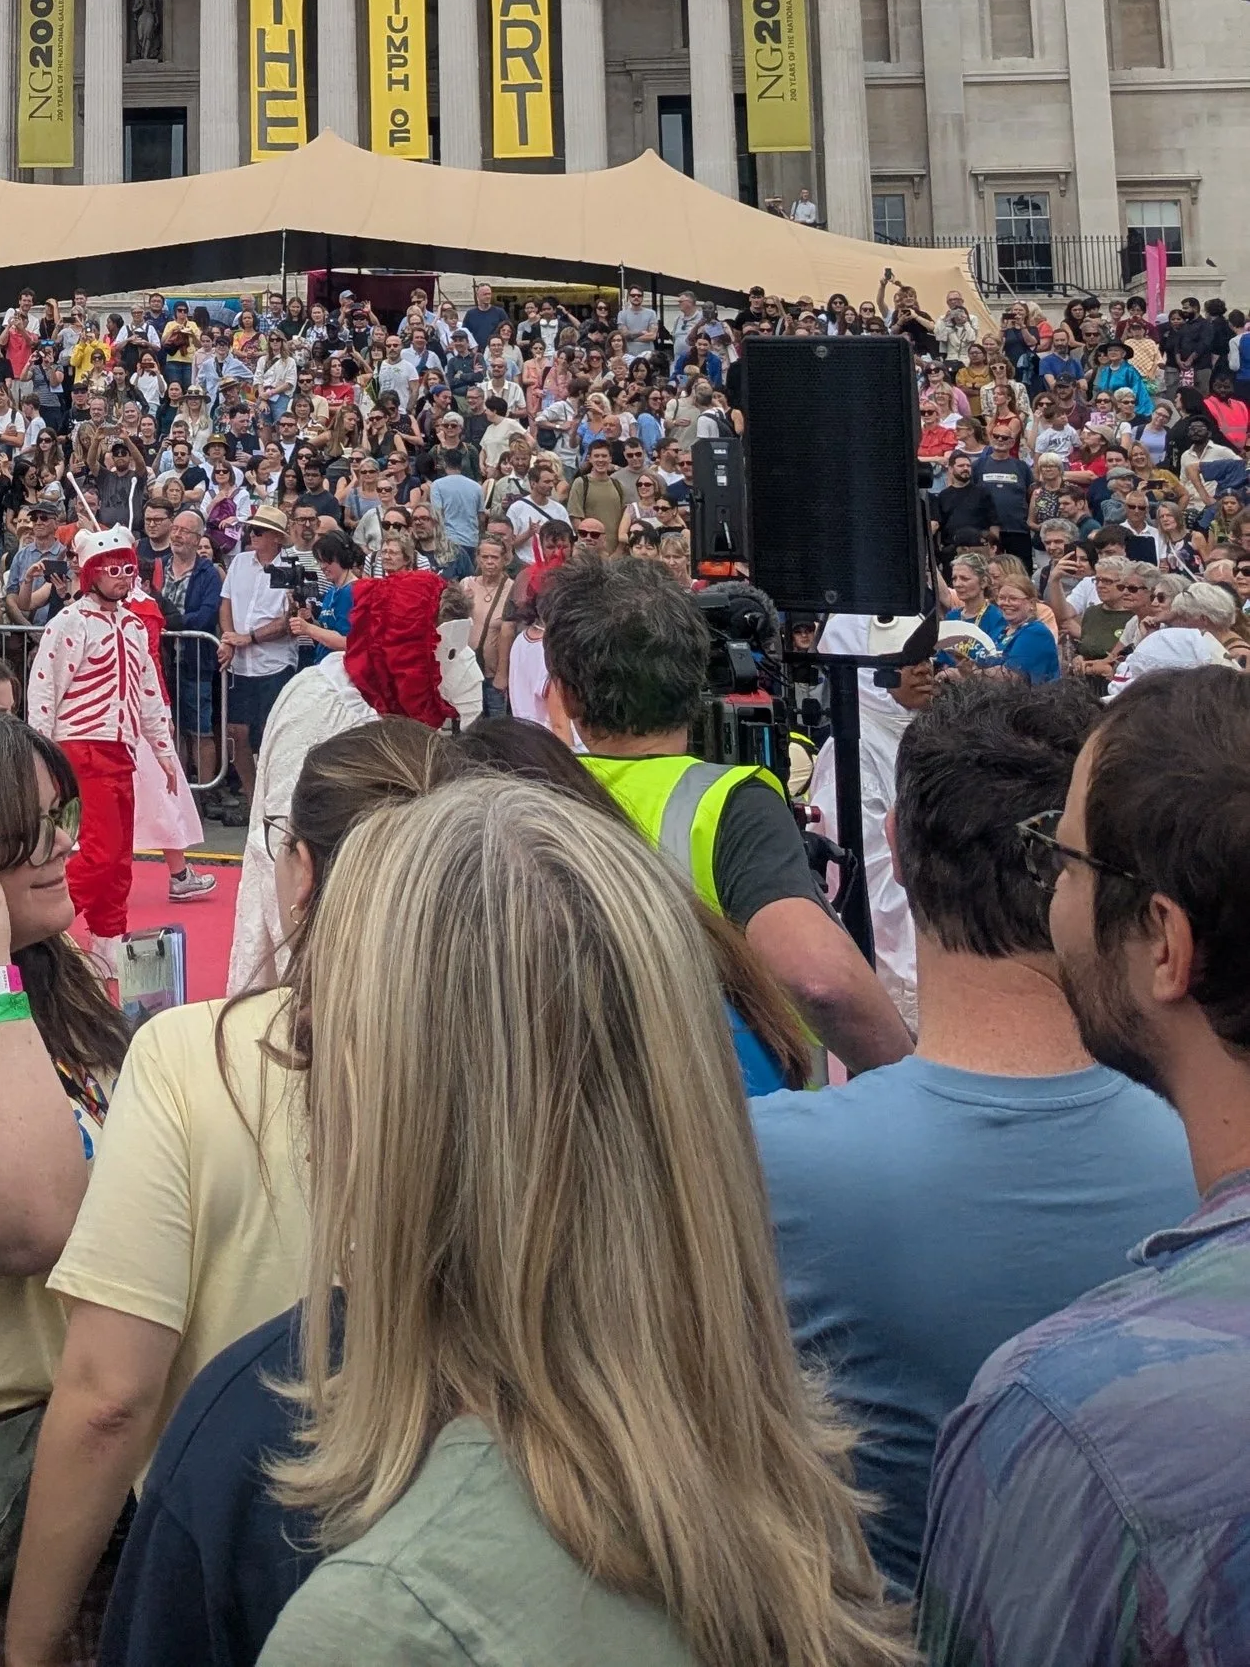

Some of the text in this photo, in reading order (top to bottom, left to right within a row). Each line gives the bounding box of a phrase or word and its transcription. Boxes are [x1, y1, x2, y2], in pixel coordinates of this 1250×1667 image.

[788, 52, 795, 61] OF
[57, 75, 63, 84] OF
[788, 63, 796, 86] YEARS
[789, 89, 797, 101] 200
[388, 108, 411, 147] OF
